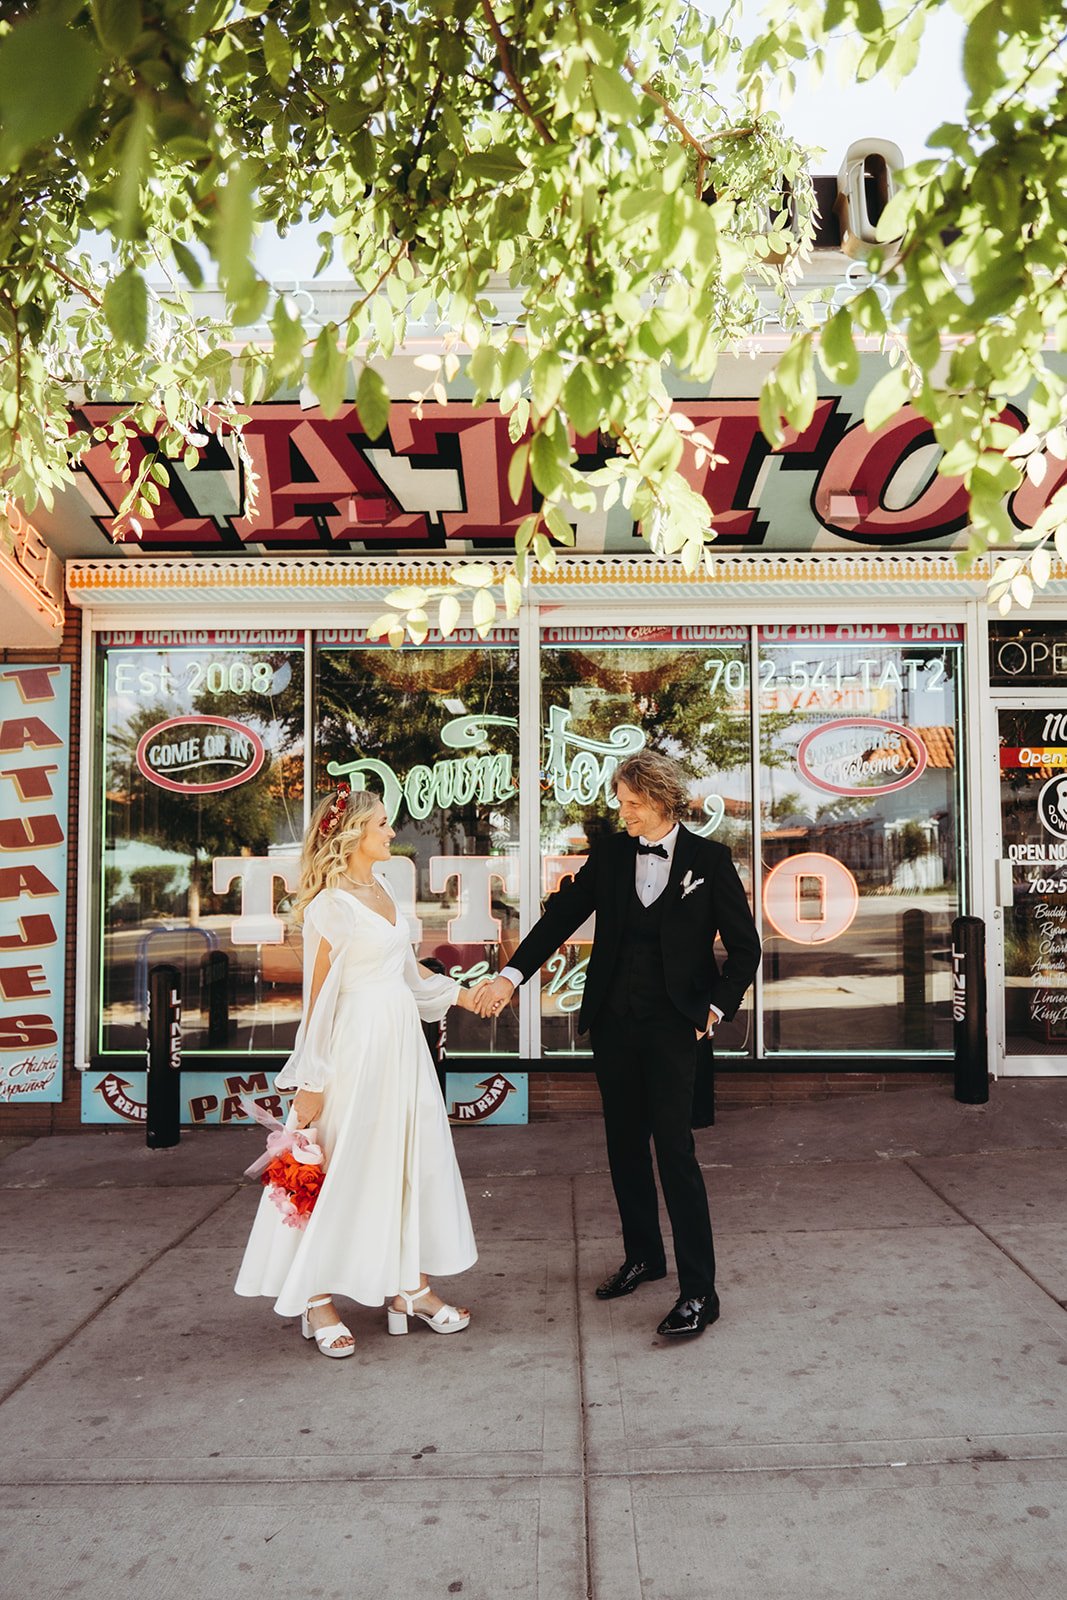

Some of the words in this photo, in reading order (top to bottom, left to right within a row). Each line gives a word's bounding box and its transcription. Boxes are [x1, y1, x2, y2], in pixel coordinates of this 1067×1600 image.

[74, 400, 1067, 546] TATTO
[763, 624, 825, 640] OPEN
[835, 624, 887, 640] ALL
[898, 624, 959, 640] YEAR
[186, 662, 274, 695] 2008
[149, 738, 200, 766] COME
[204, 734, 227, 758] ON
[230, 737, 250, 760] IN
[1018, 748, 1062, 767] Open
[0, 666, 65, 1051] TATUAJES
[1008, 844, 1046, 861] OPEN
[1033, 903, 1067, 923] Buddy
[952, 943, 966, 1022] LINES
[170, 989, 182, 1068] LINES
[105, 1080, 120, 1098] IN
[459, 1105, 476, 1119] IN
[475, 1078, 506, 1112] REAR
